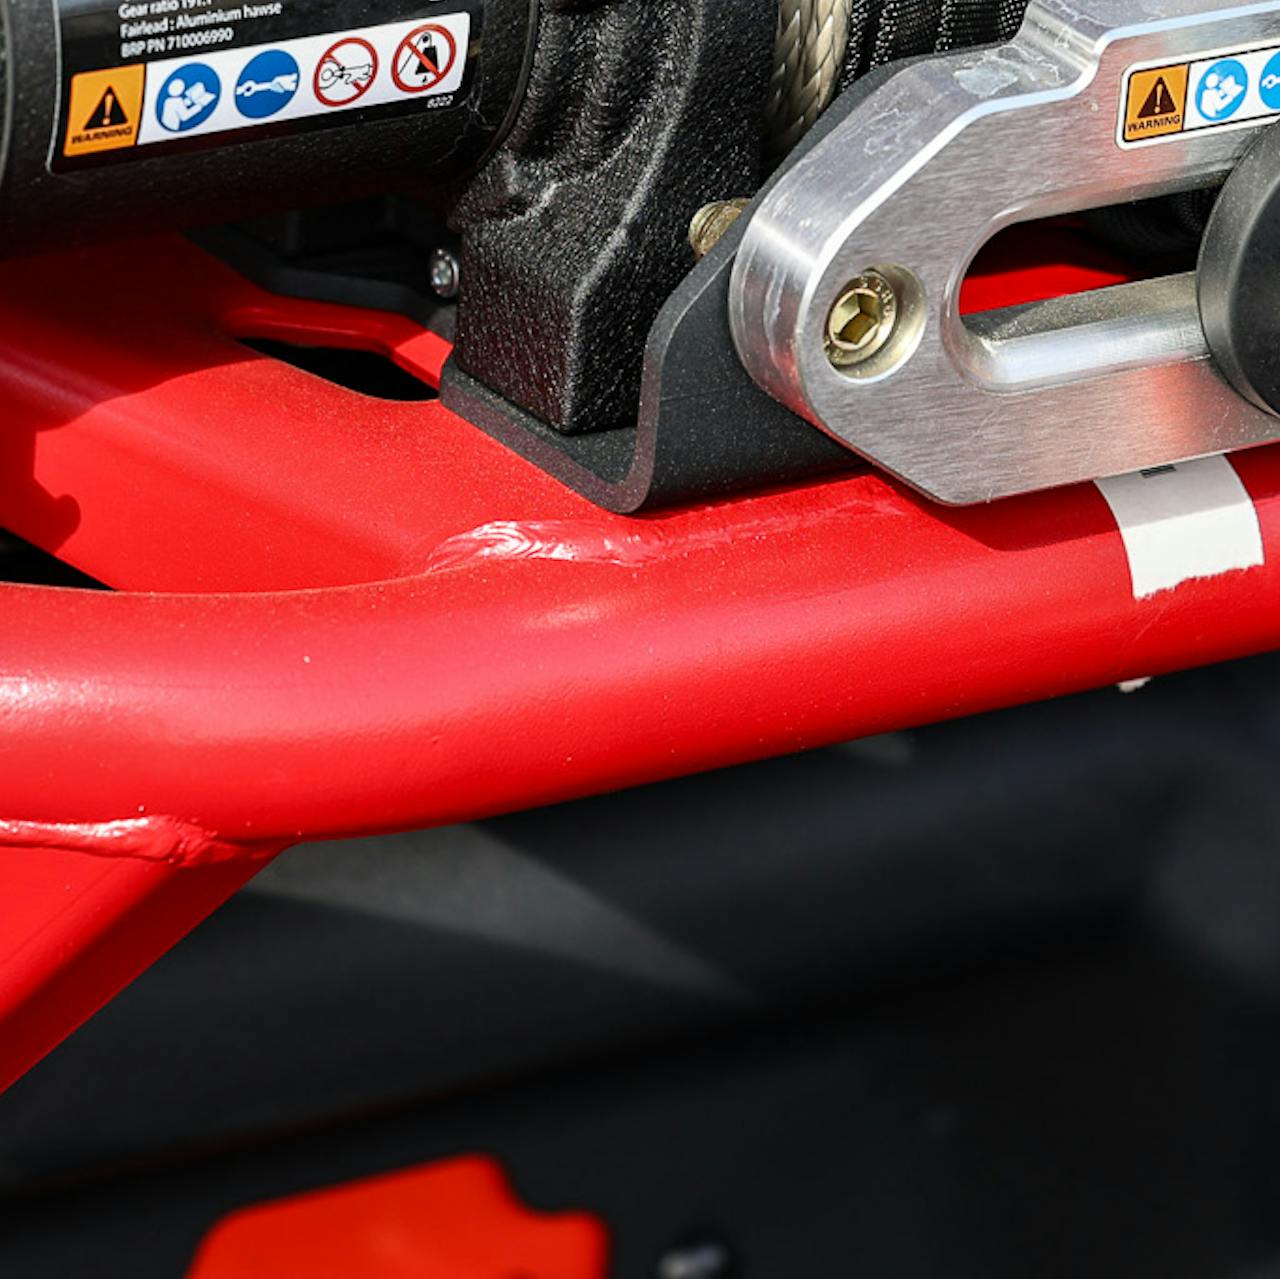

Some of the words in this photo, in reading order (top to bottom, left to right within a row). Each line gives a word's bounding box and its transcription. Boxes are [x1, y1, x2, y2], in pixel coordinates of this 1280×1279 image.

[118, 2, 149, 19] Gear
[120, 17, 168, 39] Fairlead
[176, 8, 241, 30] Aluminium
[243, 2, 283, 19] hawse
[121, 40, 146, 58] BRP
[147, 37, 166, 54] PN
[1128, 114, 1181, 132] WARNING
[72, 126, 133, 144] WARNING
